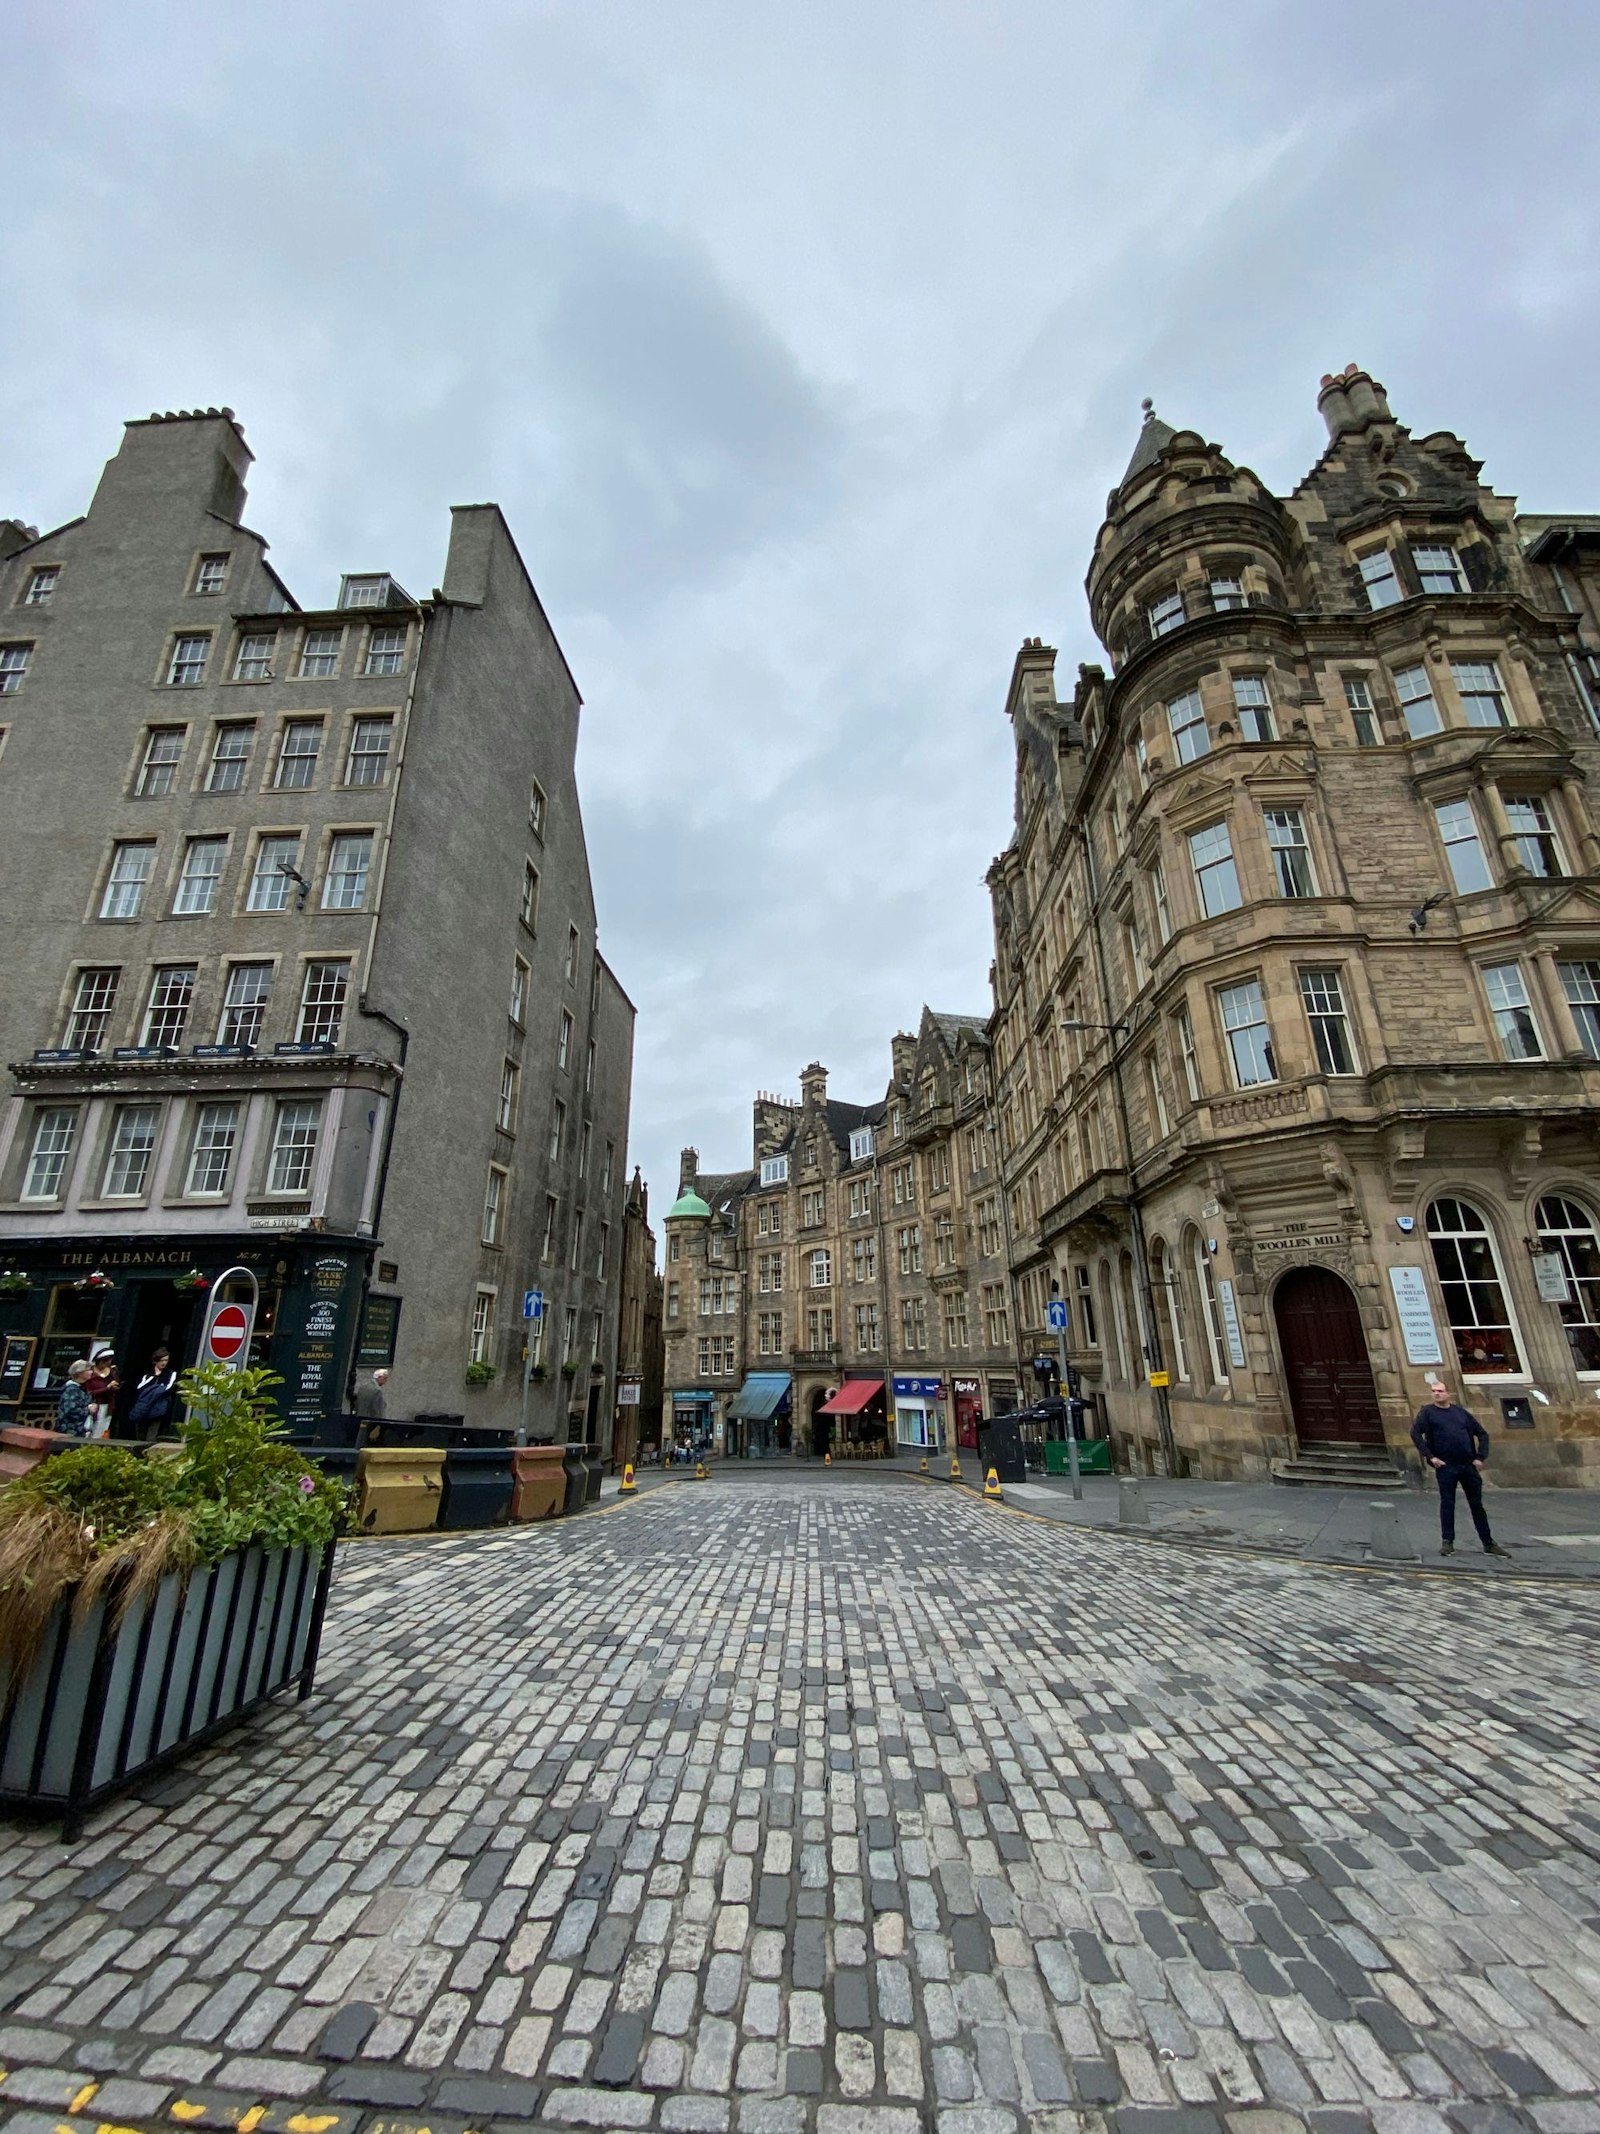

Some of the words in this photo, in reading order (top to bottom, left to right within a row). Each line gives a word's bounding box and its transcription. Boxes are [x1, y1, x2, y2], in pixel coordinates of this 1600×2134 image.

[252, 1219, 269, 1228] HIGH
[1283, 1222, 1308, 1233] THE
[1257, 1237, 1310, 1250] WOOLLEN
[1314, 1235, 1344, 1246] MILL
[62, 1253, 94, 1264] THE
[100, 1251, 191, 1263] ALBANACH
[315, 1259, 348, 1268] PURVEYOR
[317, 1271, 342, 1279] CASK
